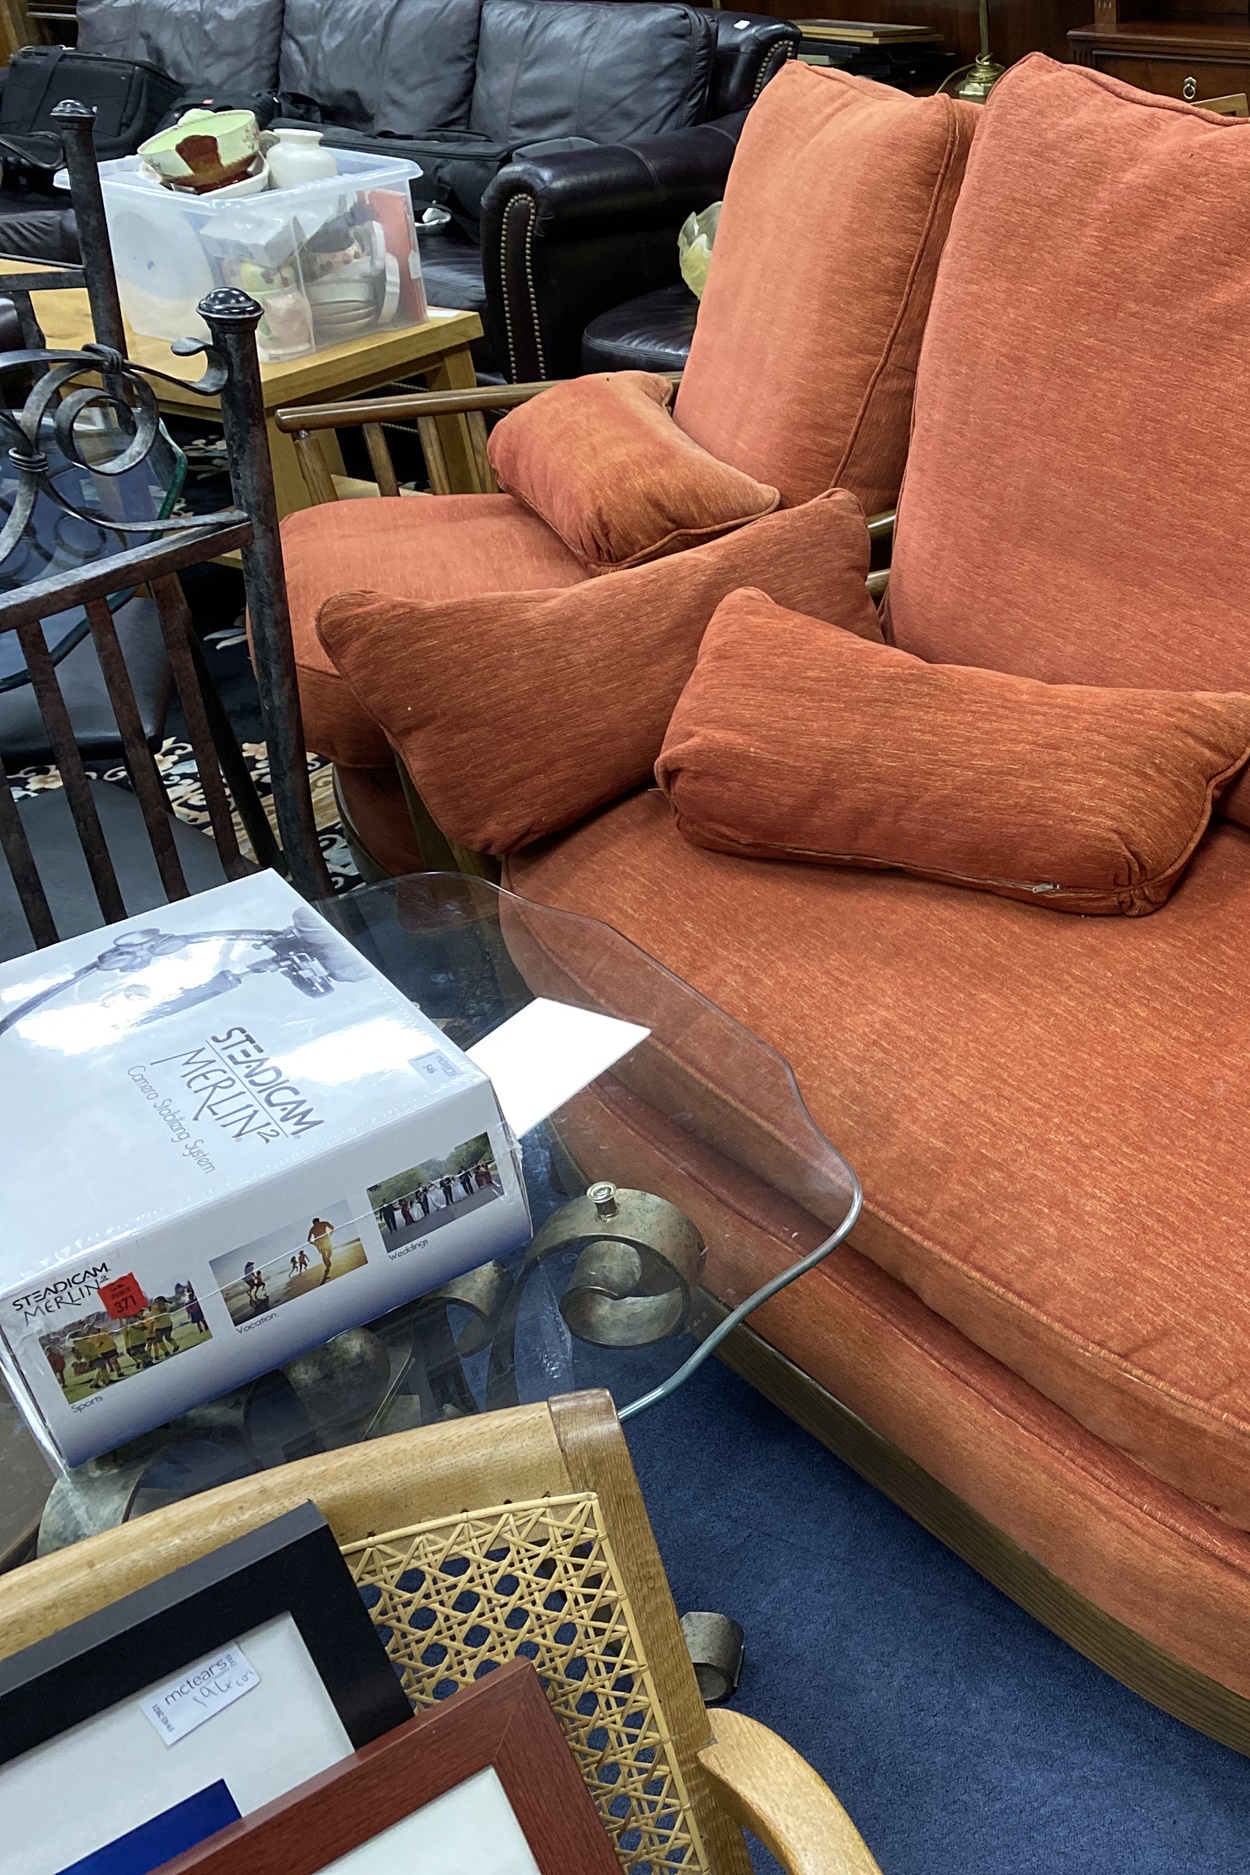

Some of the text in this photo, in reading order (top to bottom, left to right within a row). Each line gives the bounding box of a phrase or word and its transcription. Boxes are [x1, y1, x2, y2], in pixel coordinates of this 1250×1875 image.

[127, 1065, 159, 1101] Camera
[182, 1139, 216, 1174] System
[388, 1239, 429, 1261] Weddings
[12, 1262, 109, 1312] STEADICAM
[114, 1295, 137, 1314] 371
[235, 1312, 277, 1334] Vacation
[71, 1395, 104, 1413] Sports
[164, 1659, 227, 1706] mctears
